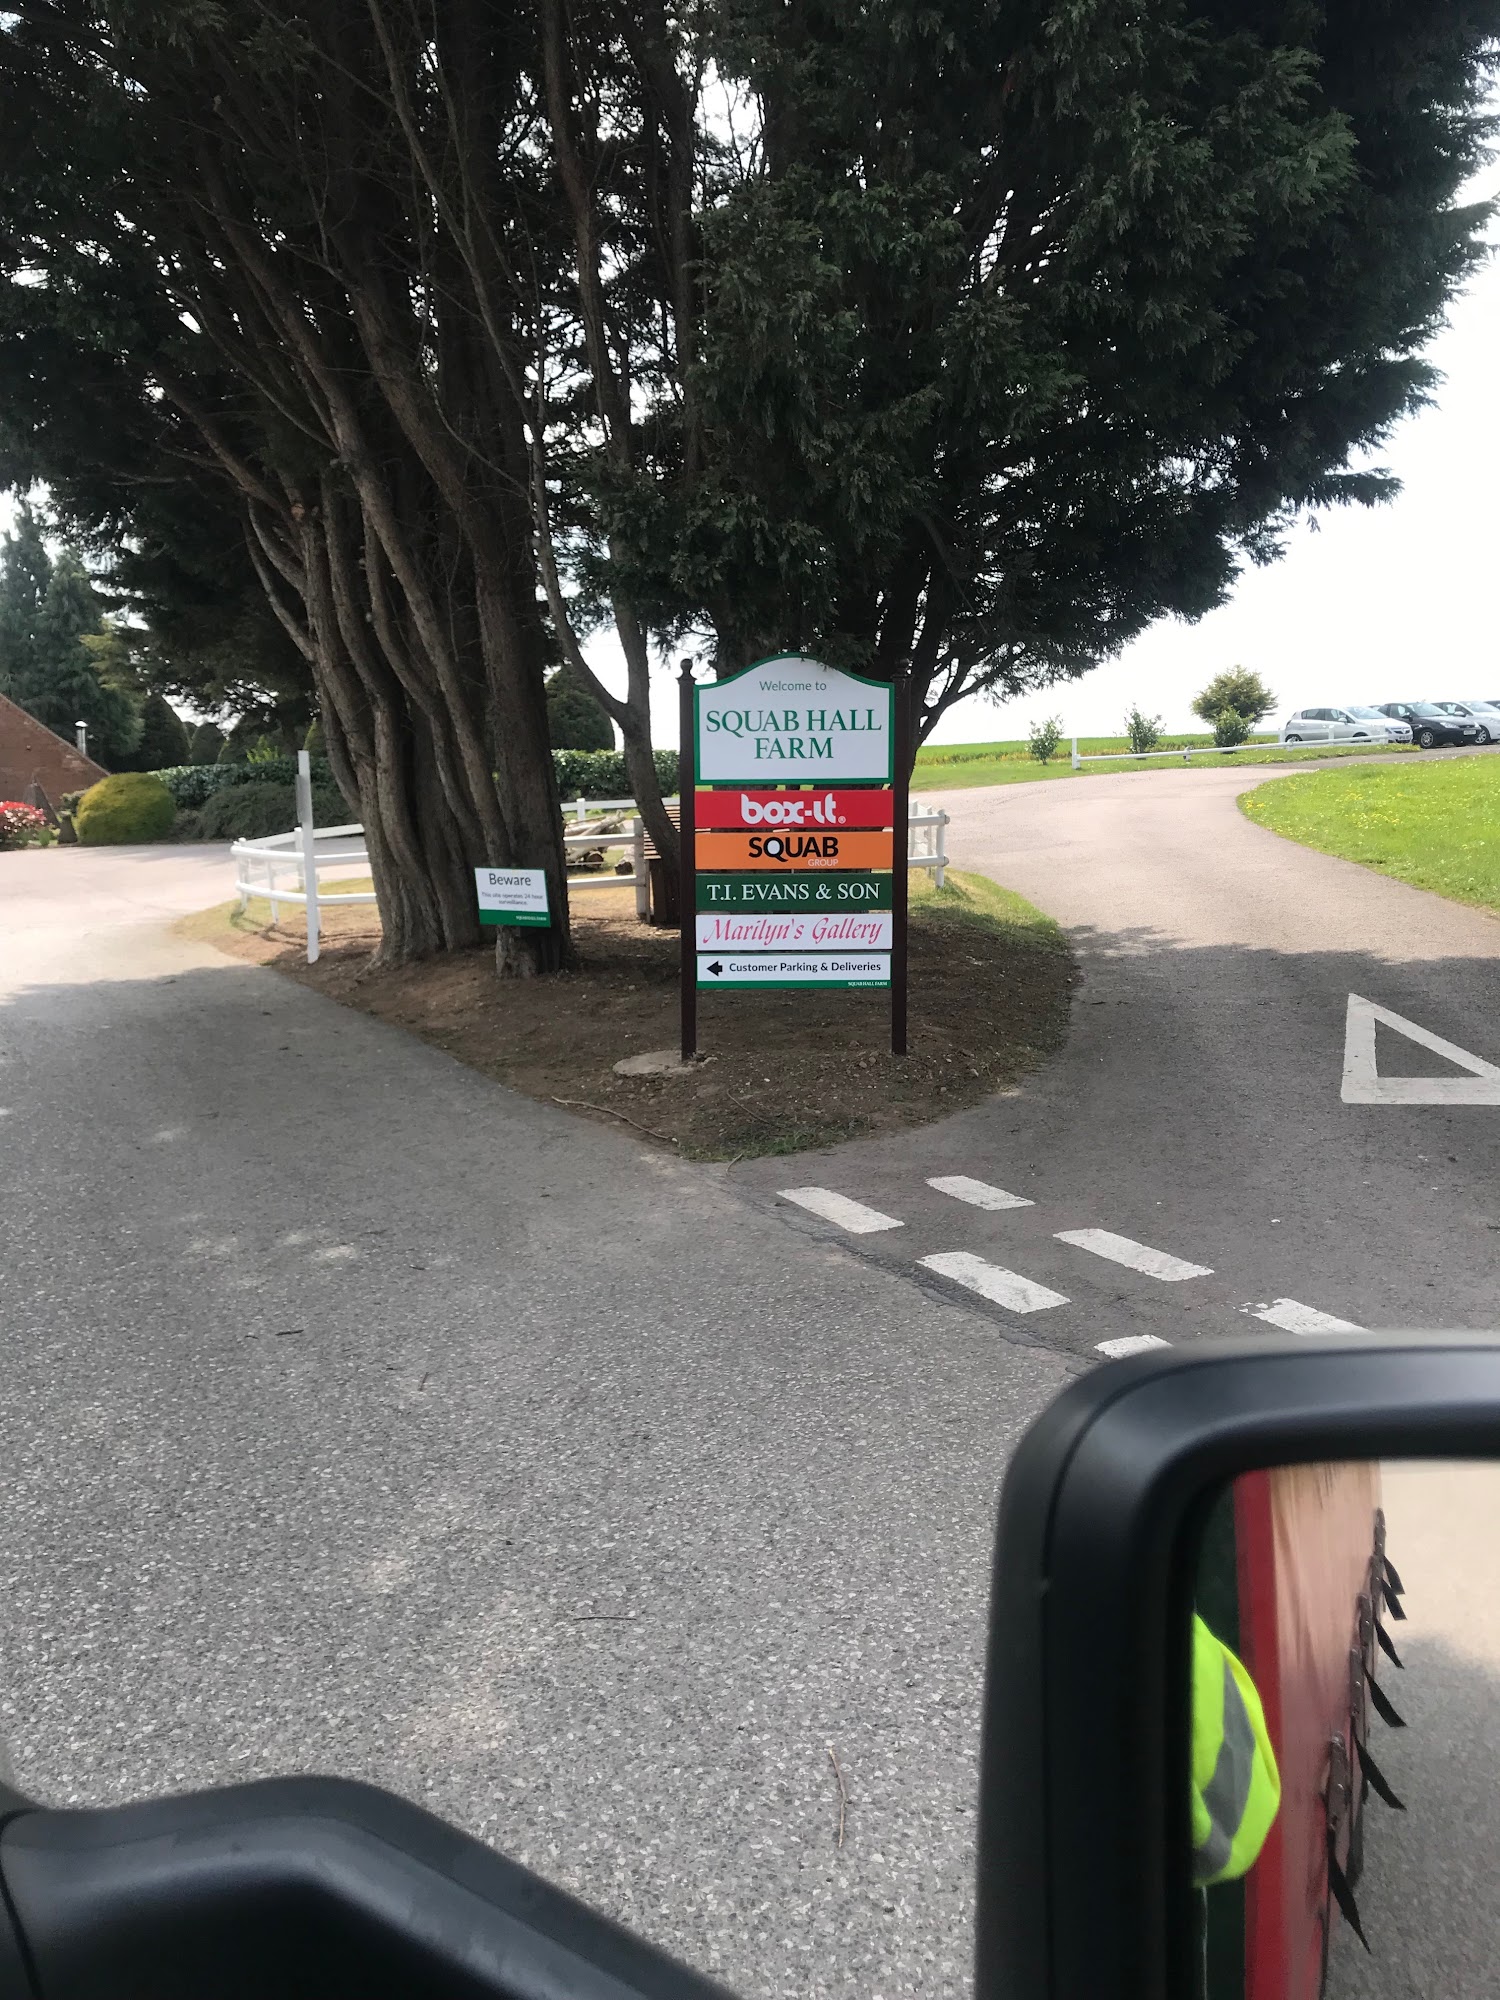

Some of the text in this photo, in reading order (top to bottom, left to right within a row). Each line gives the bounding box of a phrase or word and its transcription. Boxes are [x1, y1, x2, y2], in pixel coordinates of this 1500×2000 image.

[759, 681, 827, 691] Welcome to
[706, 709, 882, 738] SQUAB HALL
[754, 737, 834, 759] FARM
[748, 837, 838, 862] SQUAB
[489, 873, 532, 886] Beware
[707, 883, 880, 900] T.I. EVANS & SON
[703, 918, 883, 946] Marilyn's Gallery
[729, 962, 881, 973] Customer Parking & Deliveries
